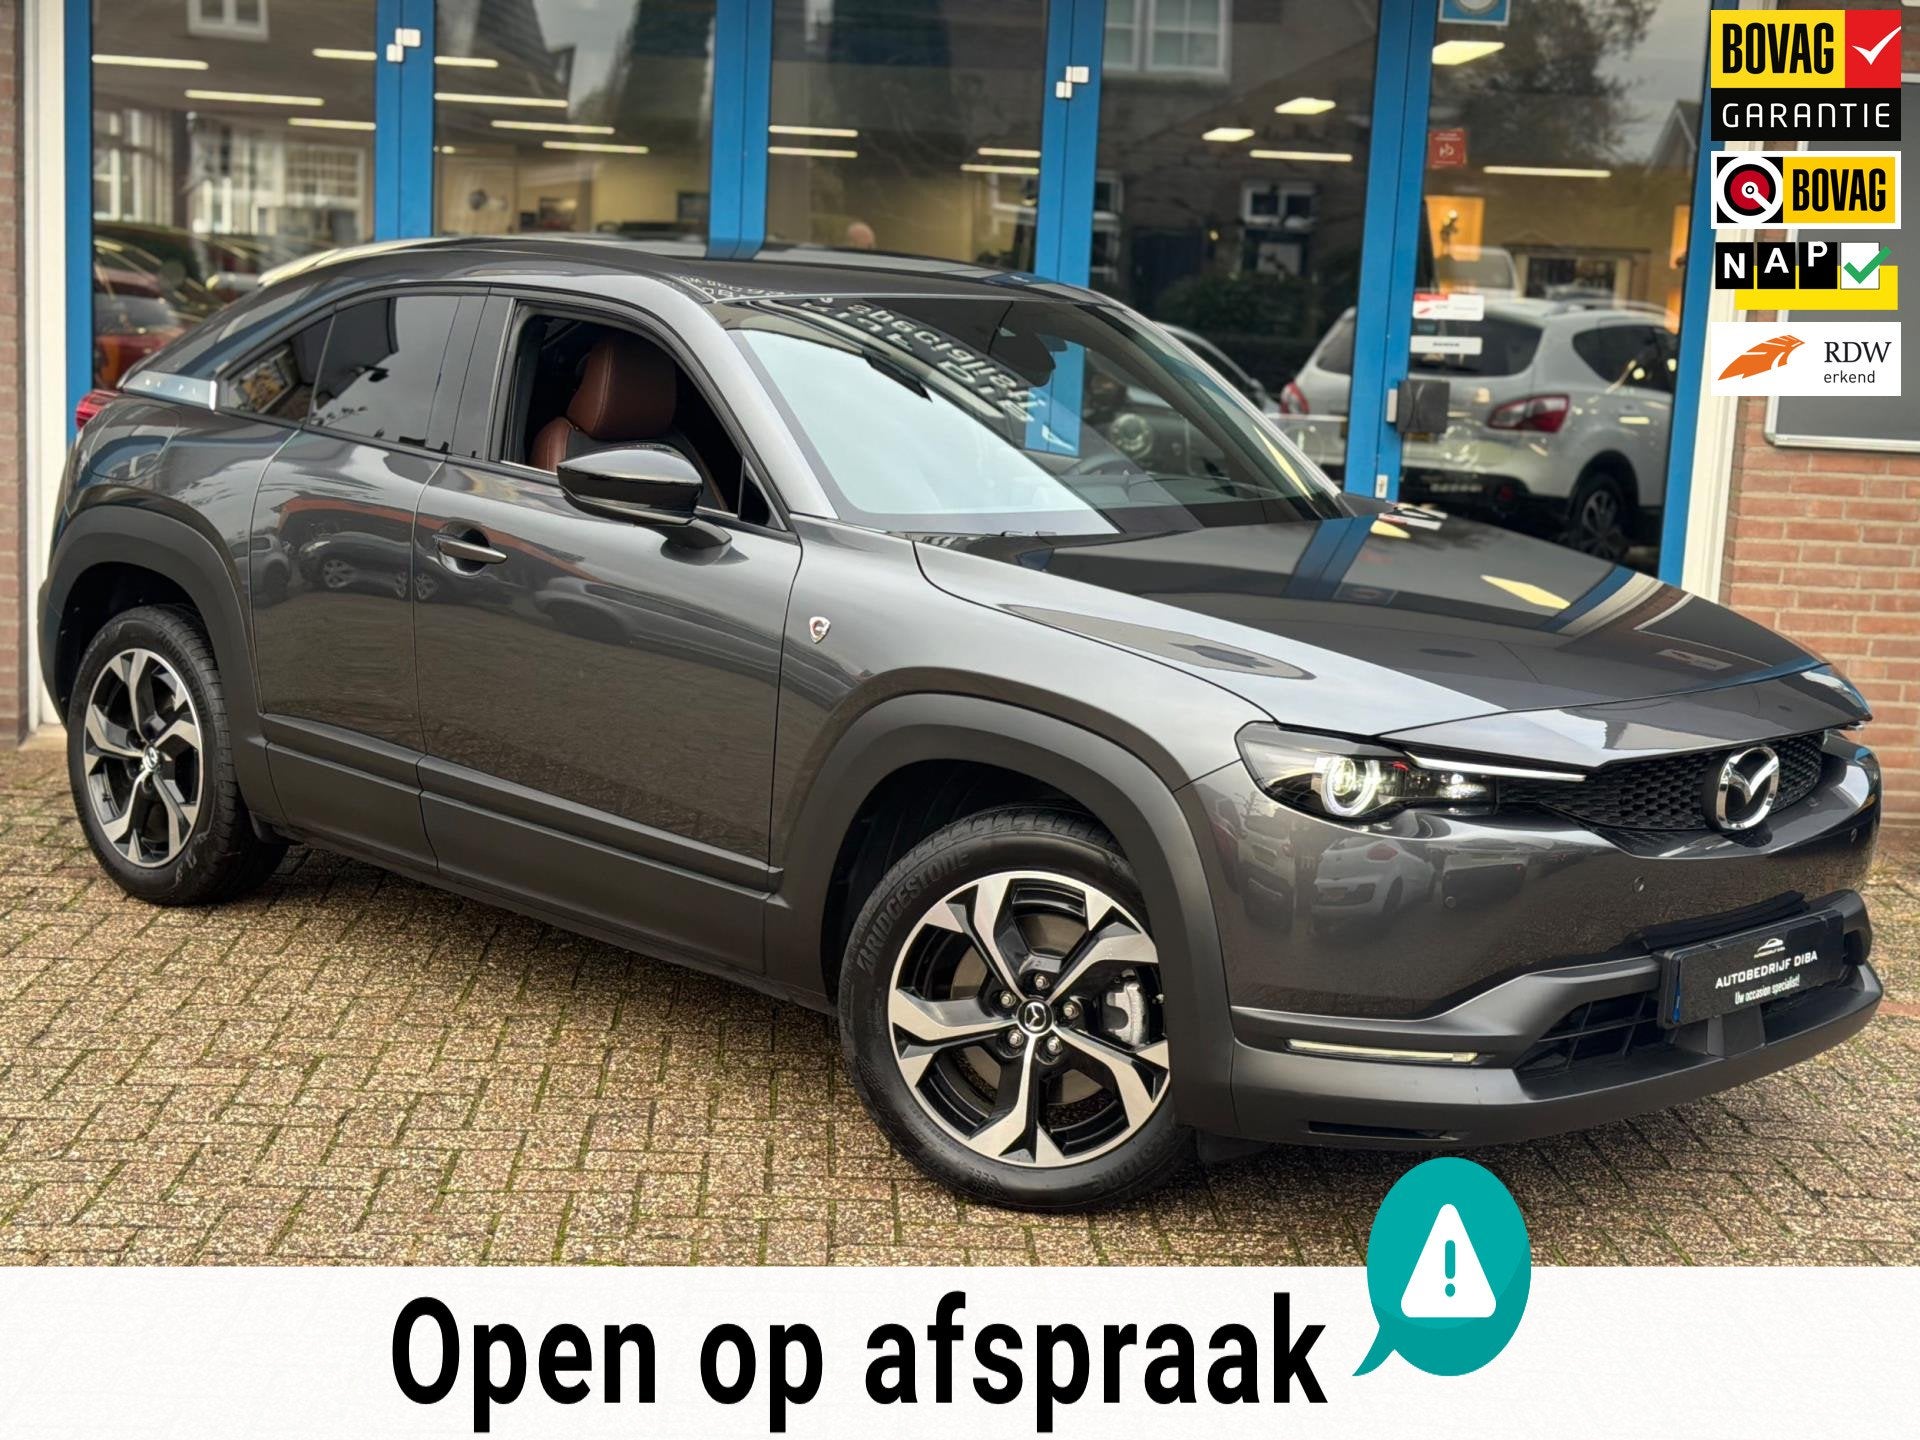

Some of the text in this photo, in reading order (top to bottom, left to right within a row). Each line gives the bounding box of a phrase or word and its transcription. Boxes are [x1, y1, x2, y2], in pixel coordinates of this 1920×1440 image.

[1715, 957, 1791, 989] AUTOBEDRIJF
[1793, 950, 1818, 967] DIBA
[1745, 984, 1771, 1001] occasion
